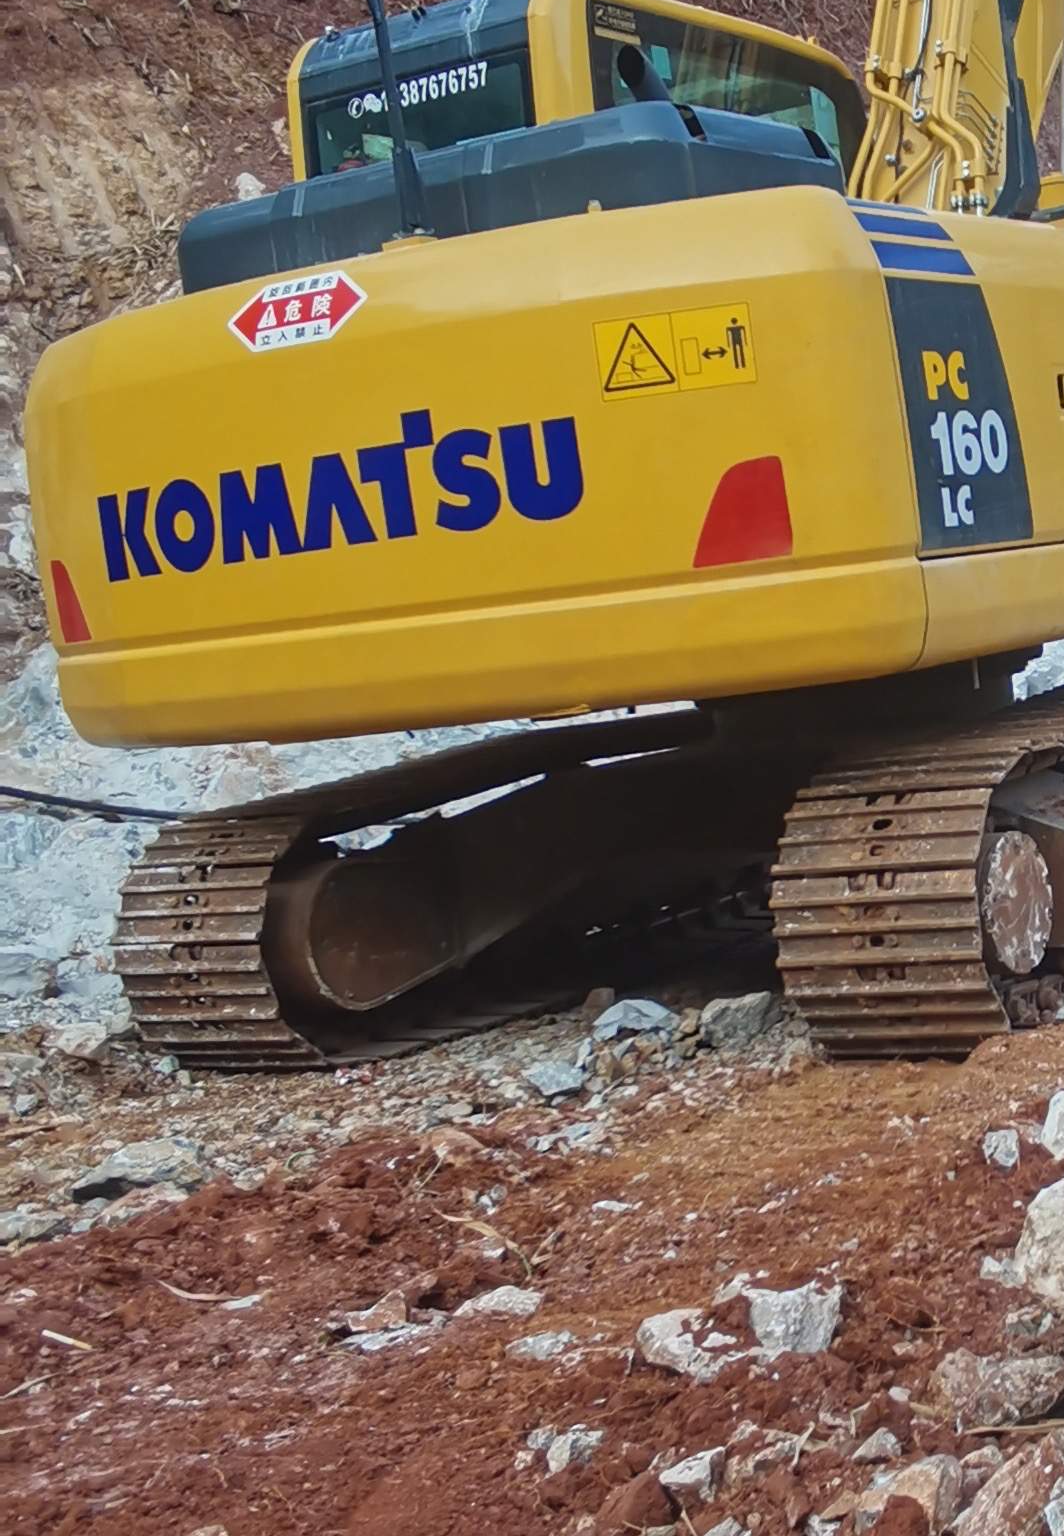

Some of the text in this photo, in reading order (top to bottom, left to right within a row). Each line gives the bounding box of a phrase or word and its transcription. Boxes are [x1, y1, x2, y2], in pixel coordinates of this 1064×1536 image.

[380, 61, 488, 112] 1387676757
[922, 350, 970, 401] PC
[930, 409, 1009, 476] 160
[97, 409, 585, 583] KOMATSU
[941, 484, 975, 528] LC
